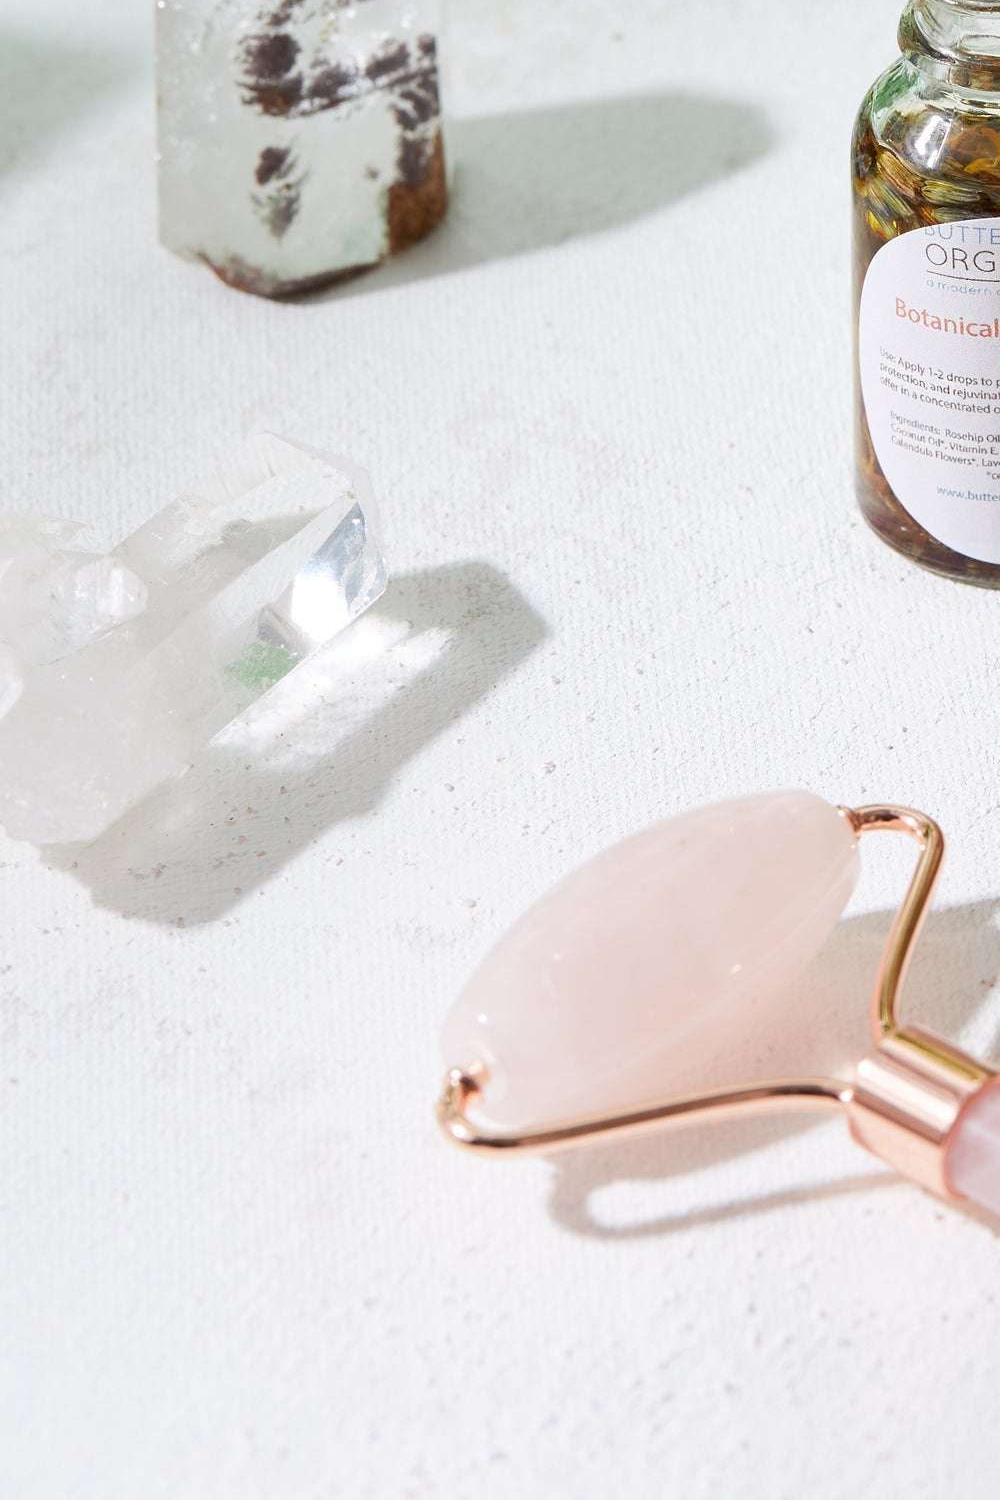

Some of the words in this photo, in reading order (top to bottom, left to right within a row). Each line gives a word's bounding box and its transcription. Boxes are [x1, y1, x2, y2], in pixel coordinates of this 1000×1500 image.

[937, 282, 992, 296] modern
[895, 296, 999, 338] Botanical
[880, 363, 928, 390] protection,
[930, 384, 950, 395] and
[898, 357, 926, 376] Apply
[928, 367, 944, 380] 1-2
[946, 373, 978, 386] drops
[981, 377, 993, 387] to
[880, 376, 898, 392] offer
[901, 386, 910, 396] in
[912, 391, 918, 399] a
[920, 394, 991, 413] concentrated
[890, 423, 925, 443] Coconut
[950, 442, 987, 455] Vitamin
[891, 436, 933, 458] Calendula
[945, 429, 984, 444] Rosehip
